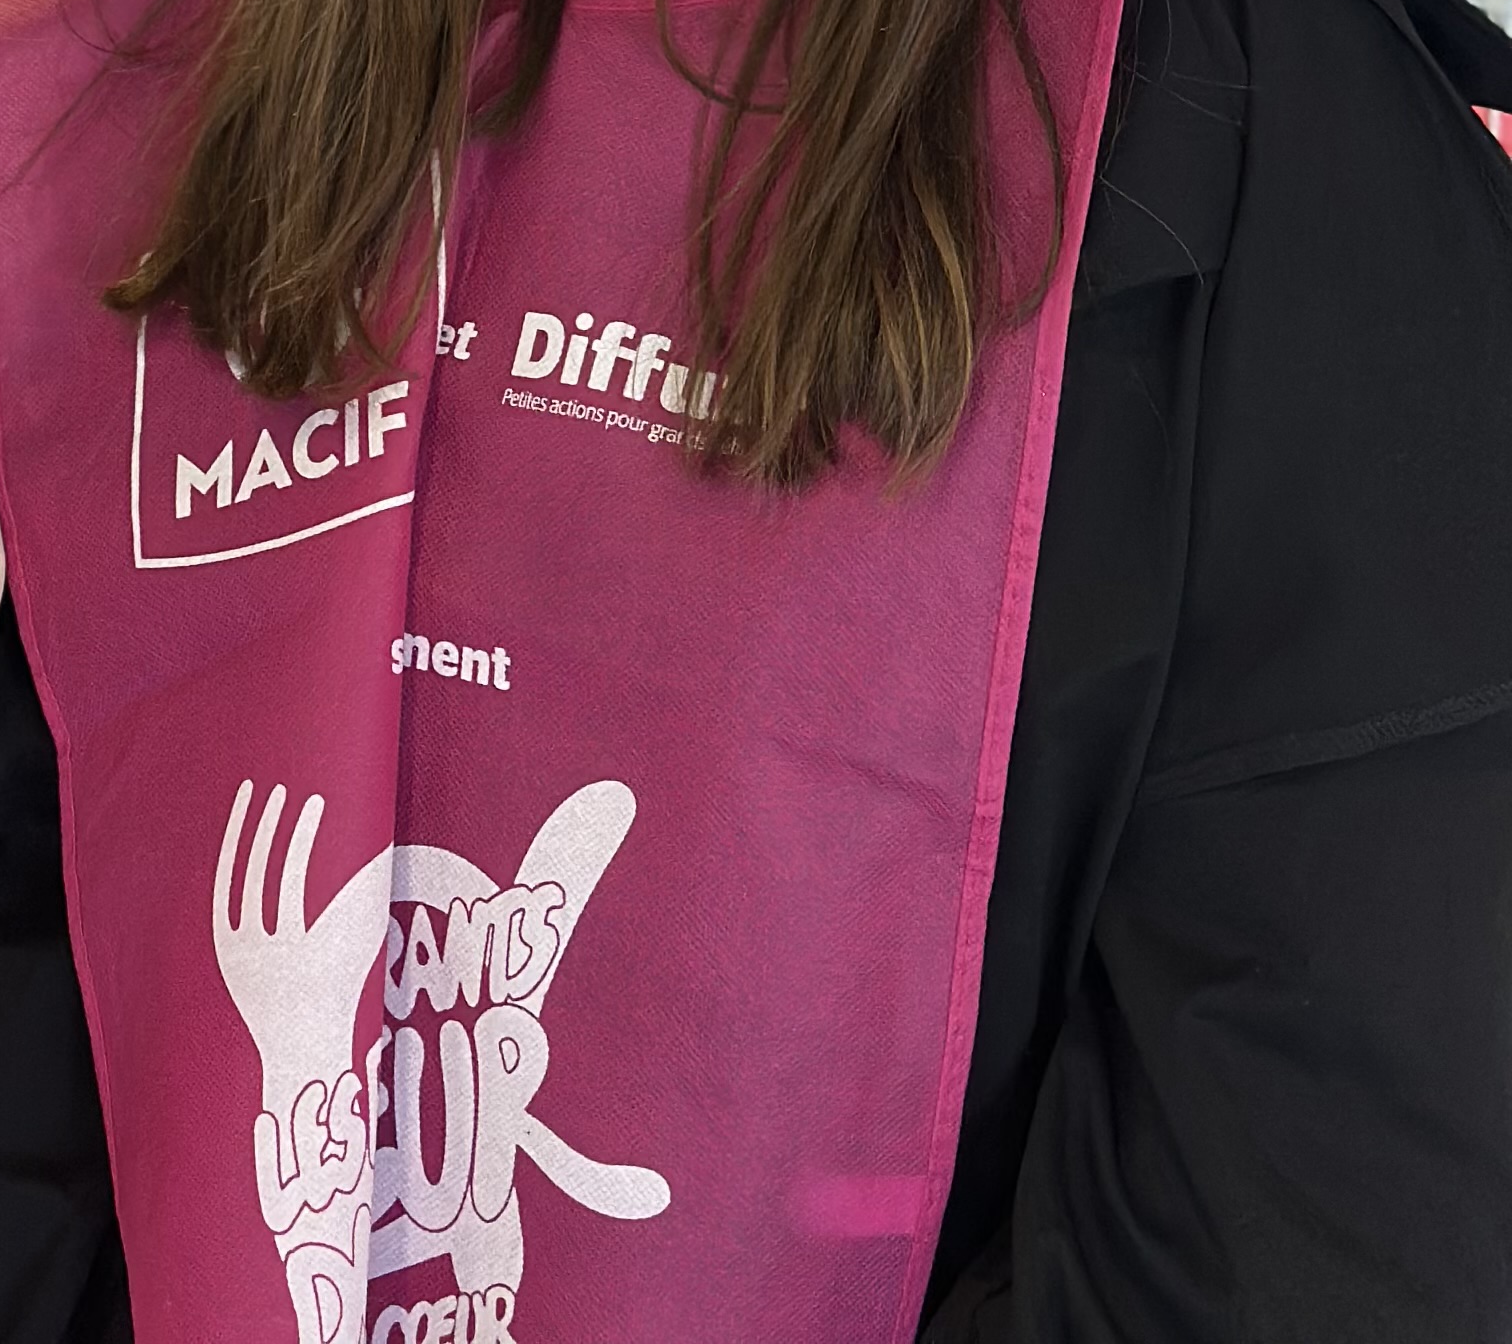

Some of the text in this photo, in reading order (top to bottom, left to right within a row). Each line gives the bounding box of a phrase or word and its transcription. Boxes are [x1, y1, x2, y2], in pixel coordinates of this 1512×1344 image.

[437, 312, 724, 421] et Diffu
[502, 387, 548, 412] Petites
[549, 398, 604, 422] actions
[605, 409, 649, 434] pour
[175, 380, 409, 519] MACIF
[254, 1070, 368, 1234] LES
